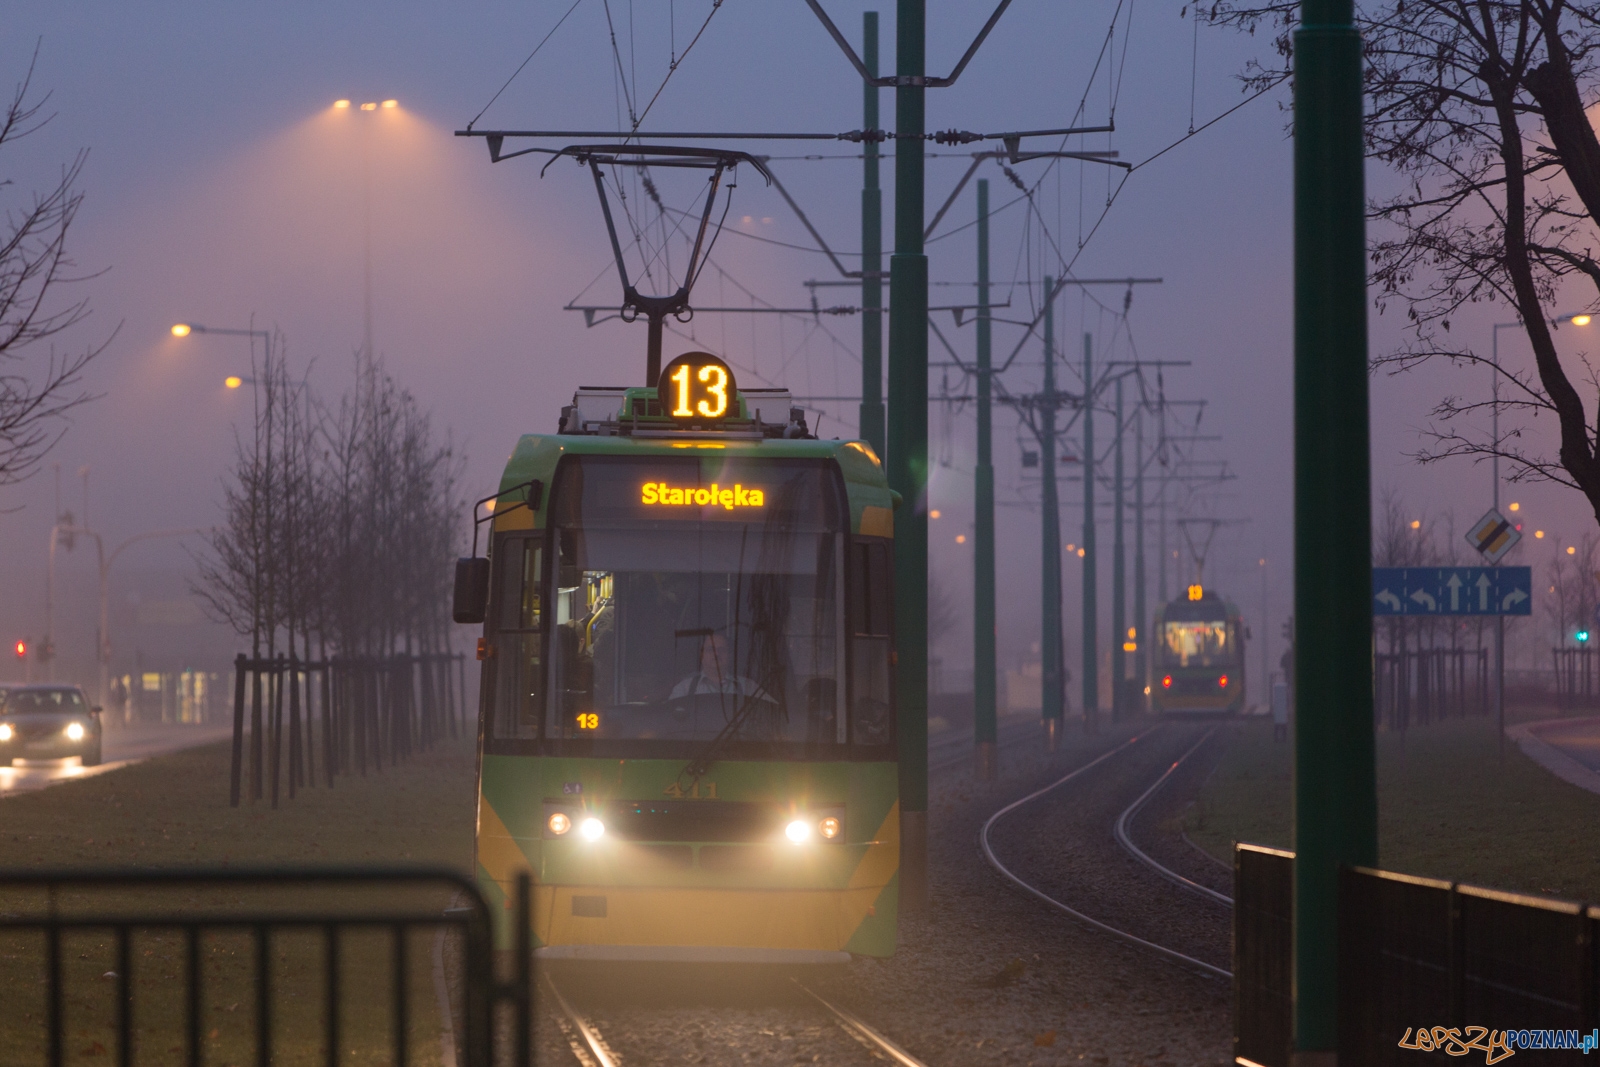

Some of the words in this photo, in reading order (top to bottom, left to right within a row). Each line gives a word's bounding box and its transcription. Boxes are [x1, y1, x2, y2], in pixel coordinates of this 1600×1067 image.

[671, 365, 728, 418] 13
[641, 482, 764, 510] Starołęka
[576, 713, 599, 729] 13
[663, 781, 719, 799] 411
